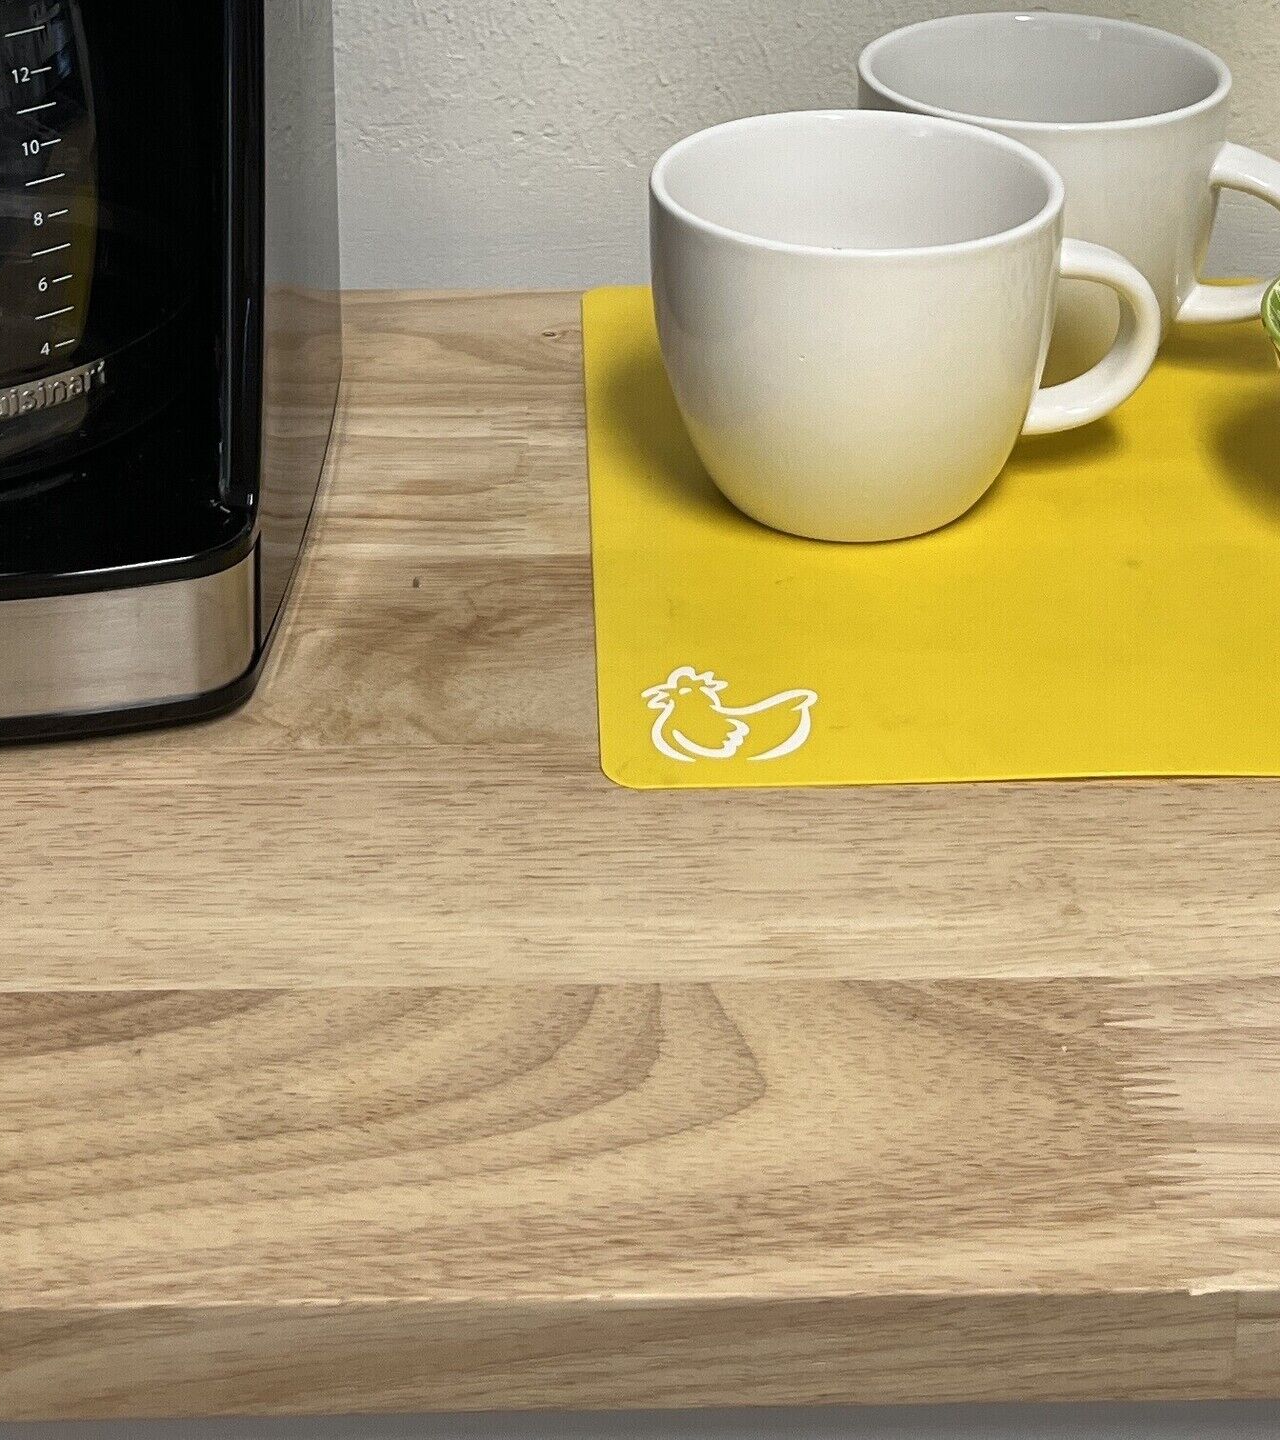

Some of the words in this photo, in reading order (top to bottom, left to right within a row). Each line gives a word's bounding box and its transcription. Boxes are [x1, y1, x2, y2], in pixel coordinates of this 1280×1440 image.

[11, 66, 31, 84] 12
[21, 139, 40, 156] 10
[33, 211, 44, 227] 8
[37, 276, 49, 292] 6
[39, 342, 51, 356] 4
